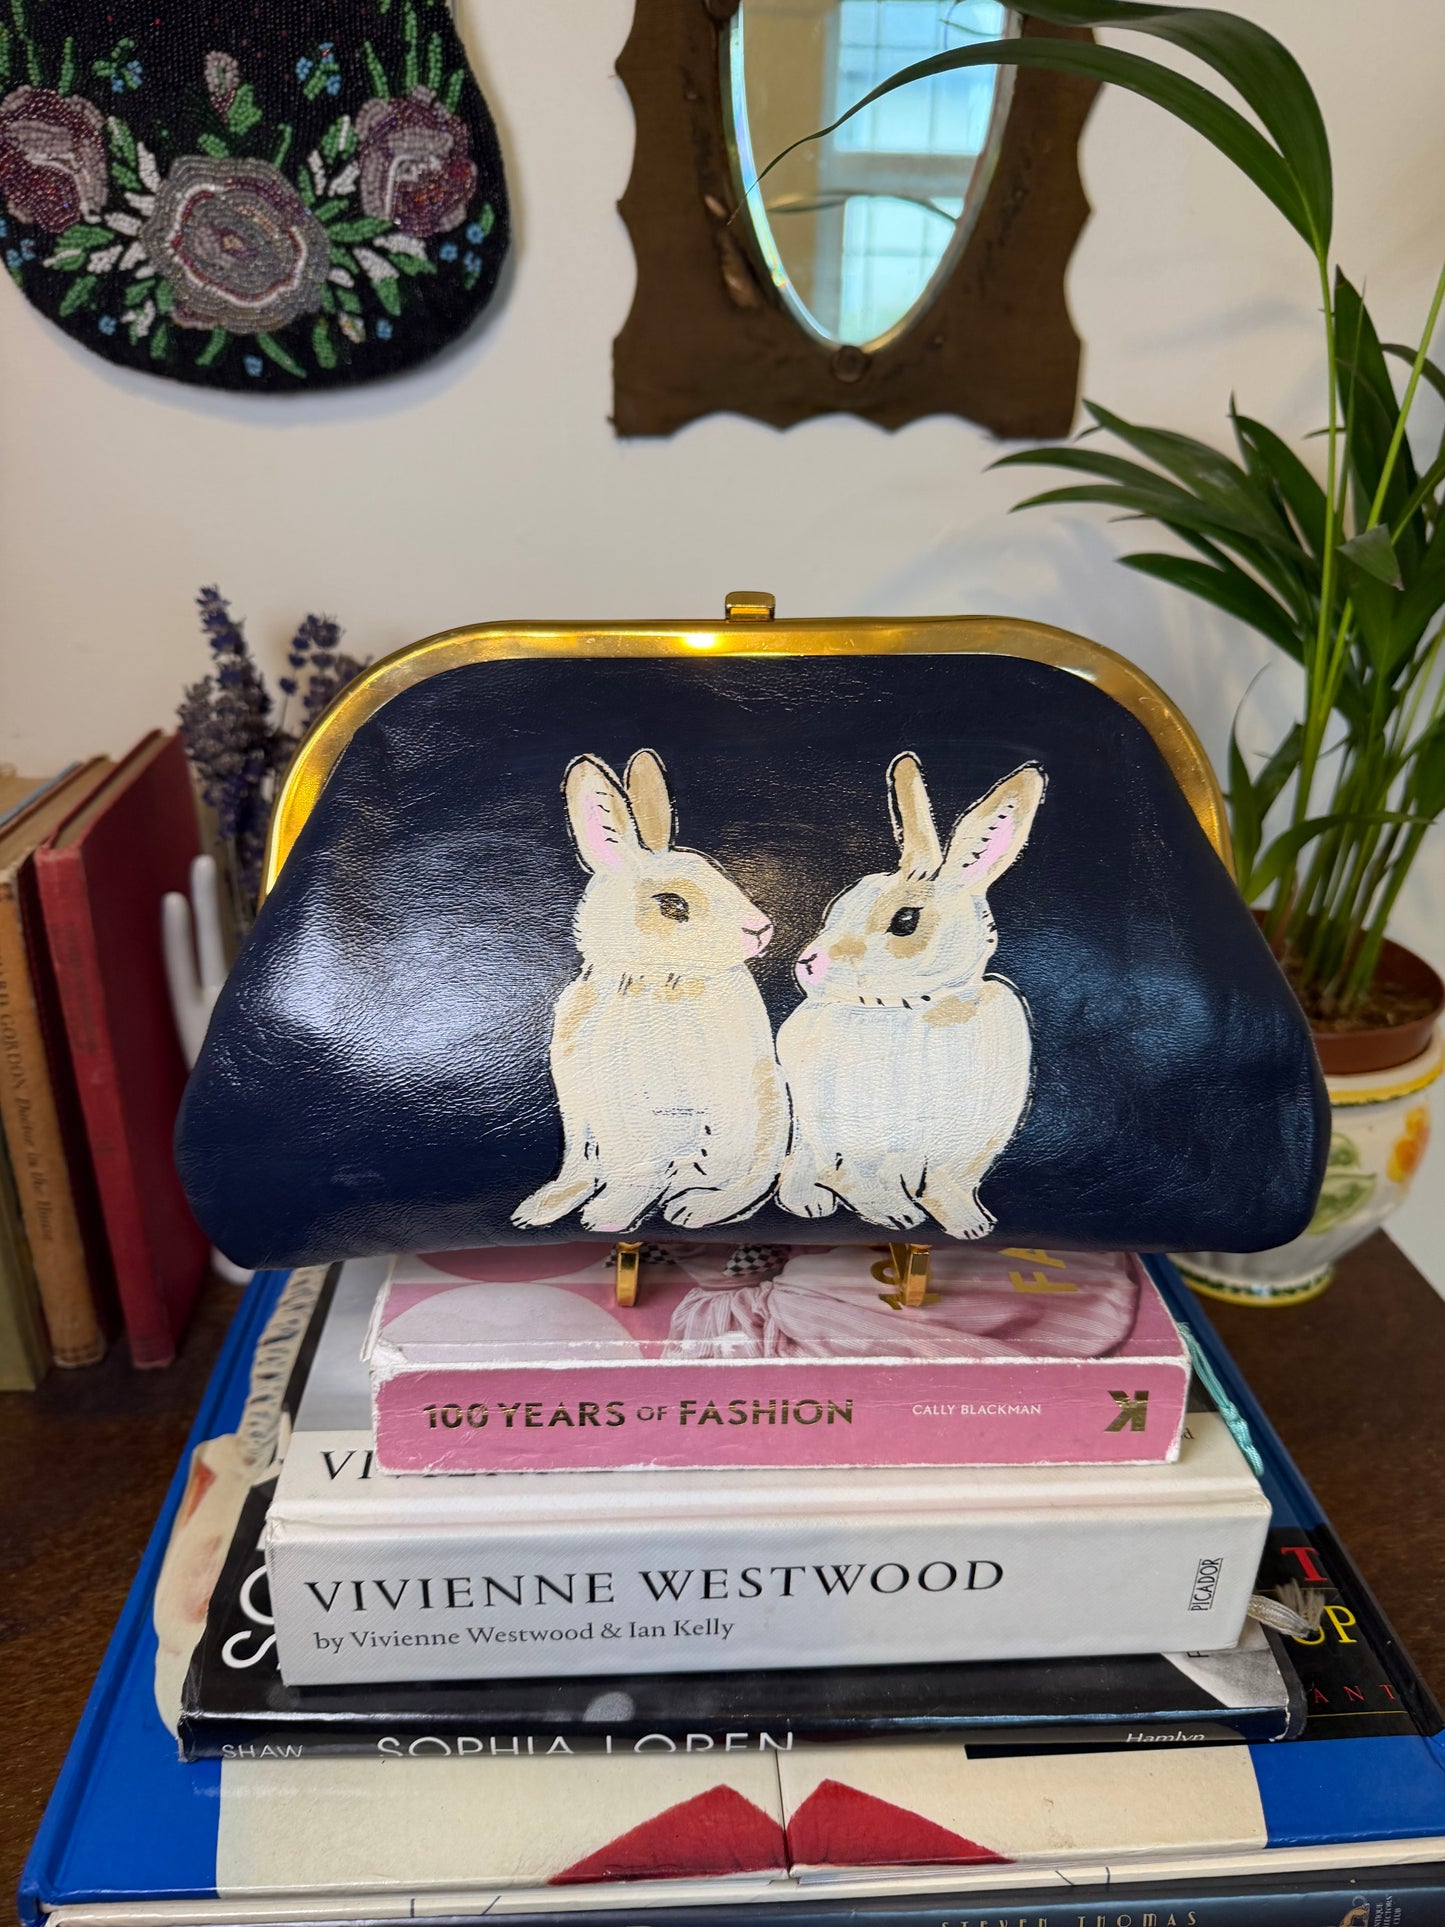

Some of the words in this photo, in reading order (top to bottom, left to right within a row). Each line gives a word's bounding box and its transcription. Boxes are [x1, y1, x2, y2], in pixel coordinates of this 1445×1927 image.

[423, 1403, 488, 1429] 100
[497, 1400, 627, 1428] YEARS
[636, 1405, 668, 1421] OF
[680, 1399, 854, 1426] FASHION
[912, 1404, 955, 1416] CALLY
[961, 1403, 1042, 1416] BLACKMAN
[305, 1571, 615, 1613] VIVIENNE
[638, 1560, 1004, 1602] WESTWOOD
[1190, 1558, 1222, 1612] PICADOR
[314, 1632, 345, 1654] by
[350, 1629, 460, 1648] Vivienne
[467, 1622, 593, 1644] Westwood
[601, 1622, 622, 1639] &
[629, 1621, 665, 1638] Ian
[673, 1618, 735, 1640] Kelly
[221, 1744, 303, 1758] SHAW
[377, 1736, 574, 1757] SOPHIA
[1126, 1730, 1205, 1742] Hamlyn
[1076, 1911, 1197, 1927] THOMAS
